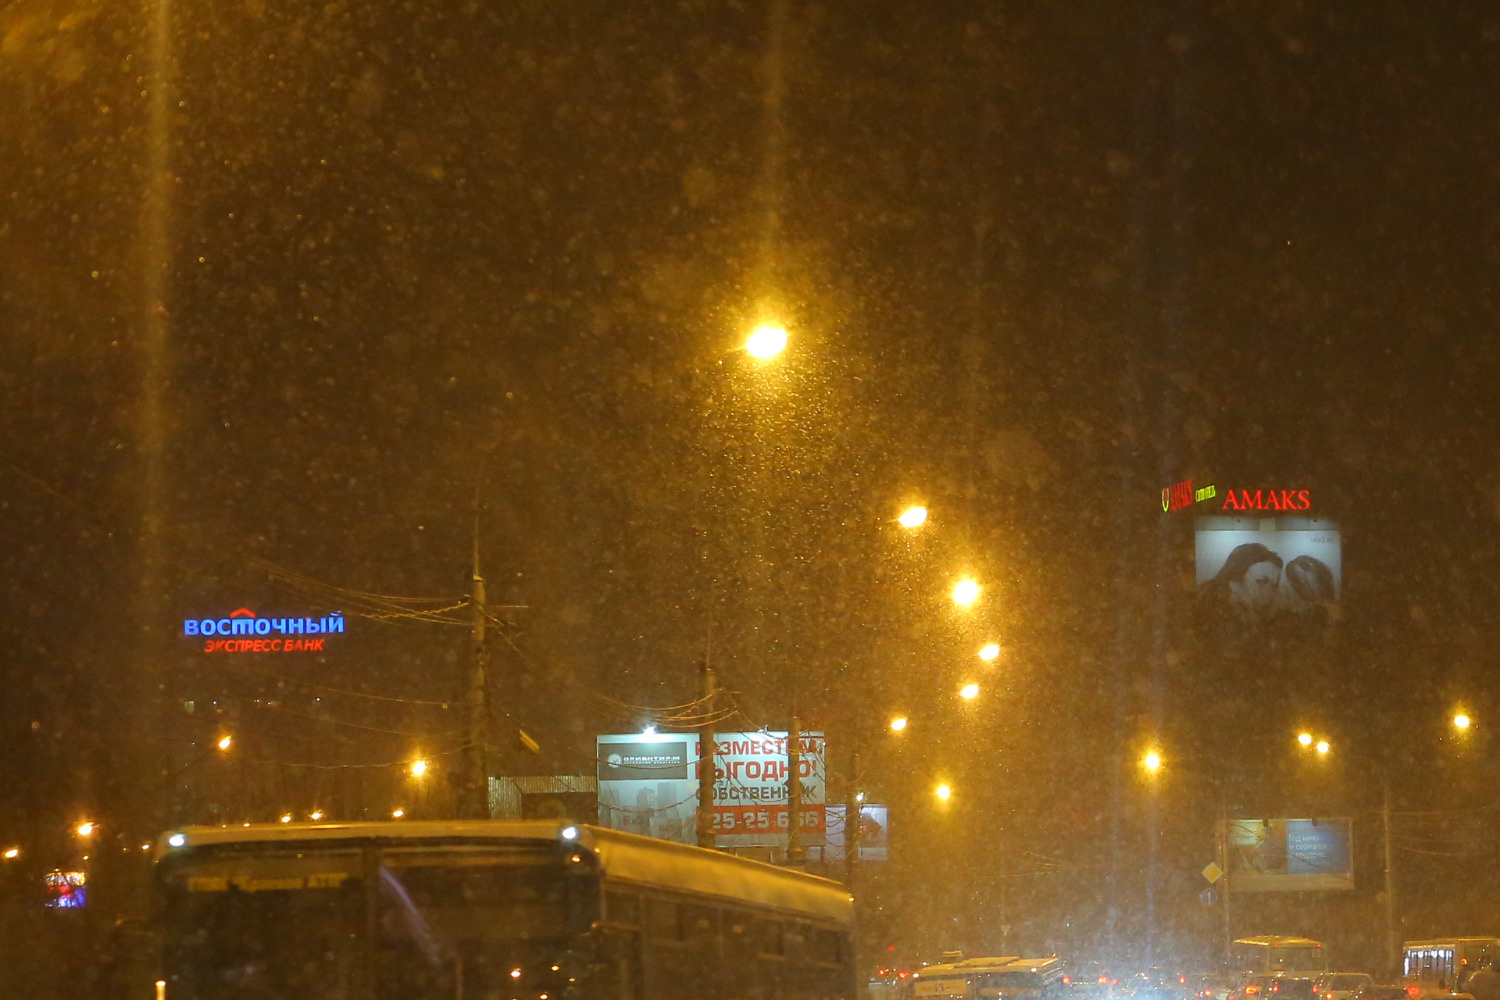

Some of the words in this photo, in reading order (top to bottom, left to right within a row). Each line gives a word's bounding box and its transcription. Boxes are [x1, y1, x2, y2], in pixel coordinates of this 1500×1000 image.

[1221, 489, 1312, 511] AMAKS
[204, 639, 282, 653] ЭКСПРЕСС
[283, 638, 326, 652] БАНК
[695, 785, 817, 801] БСТВЕННК
[712, 811, 819, 830] 25-25-66
